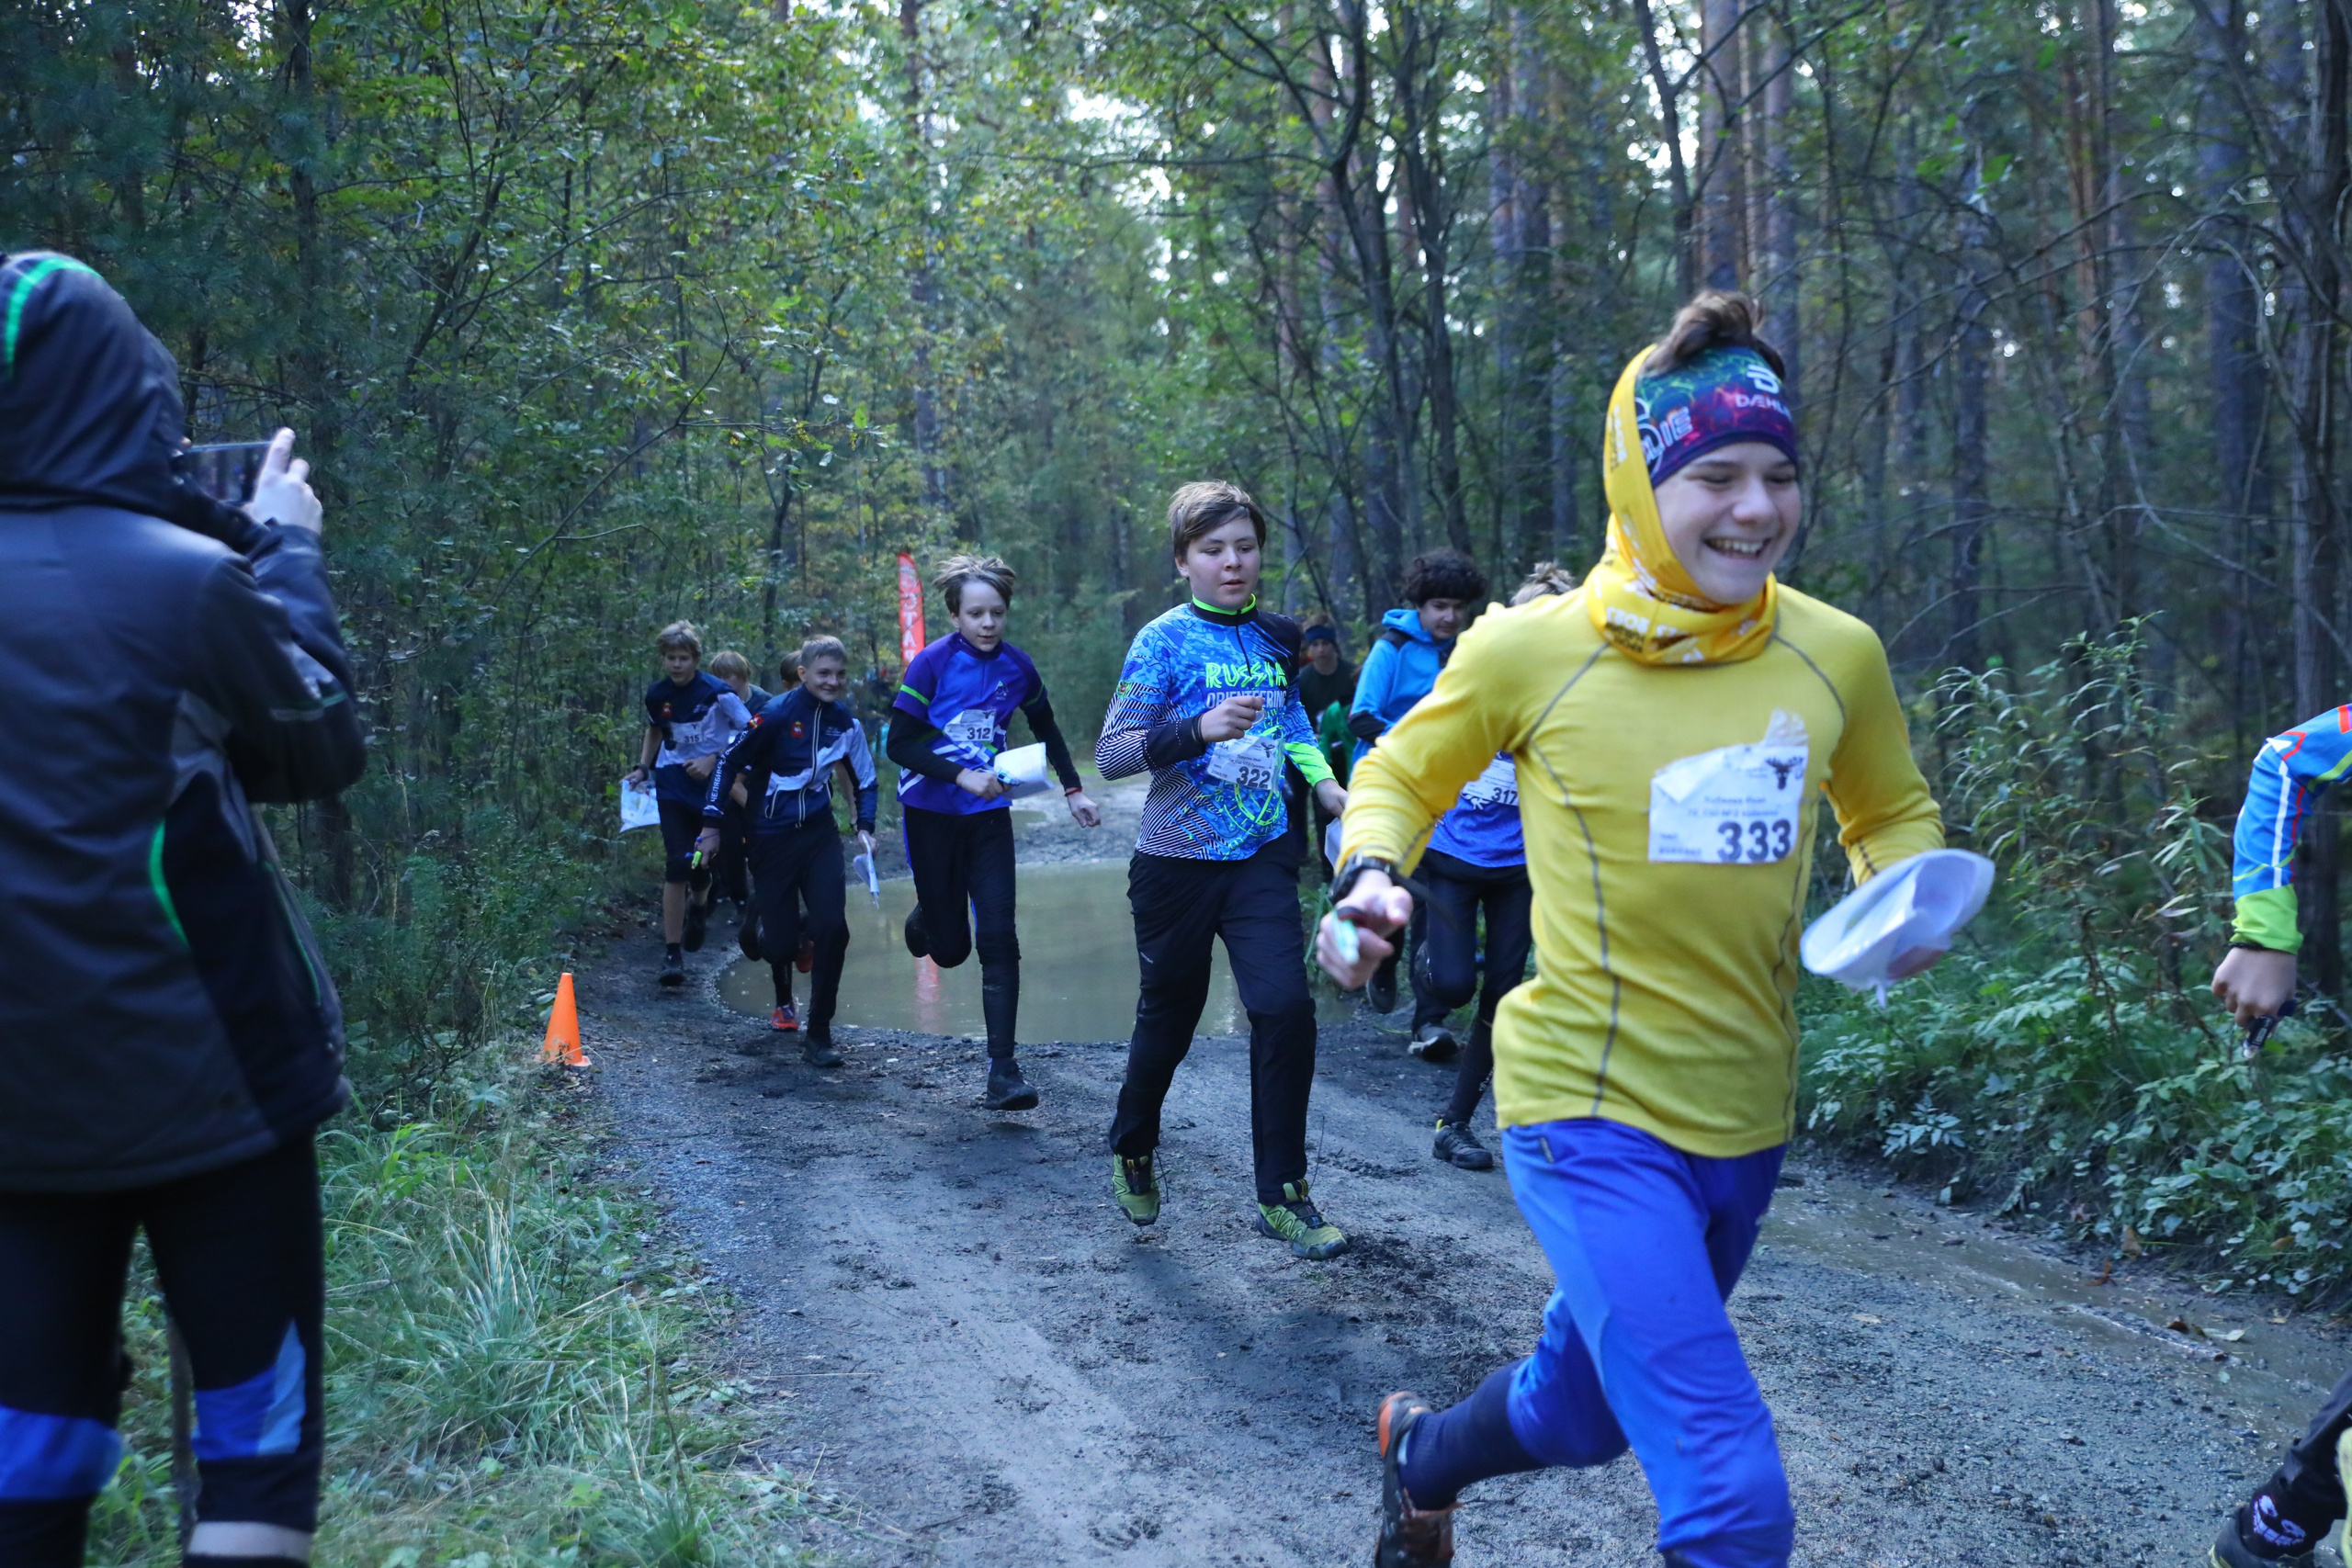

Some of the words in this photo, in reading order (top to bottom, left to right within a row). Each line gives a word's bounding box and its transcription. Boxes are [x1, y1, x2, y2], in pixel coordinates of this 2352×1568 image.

[1205, 661, 1287, 688] RUSSIA
[967, 727, 991, 740] 312
[1236, 766, 1271, 788] 322
[1491, 787, 1519, 805] 317
[1717, 819, 1792, 863] 333
